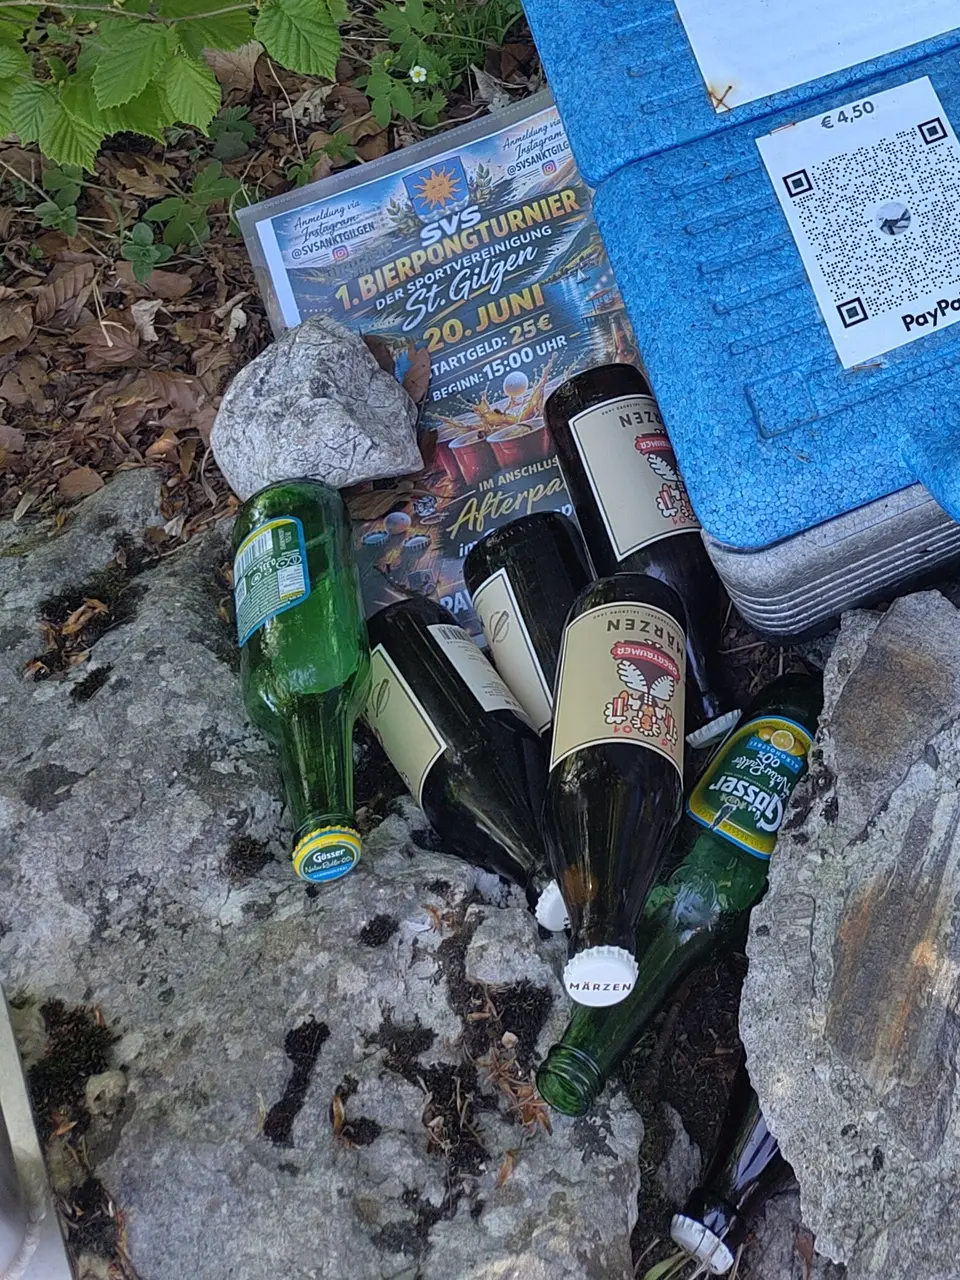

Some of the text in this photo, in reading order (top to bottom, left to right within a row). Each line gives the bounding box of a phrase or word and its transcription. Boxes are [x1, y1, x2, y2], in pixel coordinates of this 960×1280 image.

[820, 99, 876, 130] € 4,50
[503, 123, 548, 151] Anmeldung
[507, 140, 569, 176] @SVSANKTGILG
[293, 204, 346, 231] Anmeldung
[419, 203, 482, 247] SVS
[335, 189, 581, 311] 1. BIERPONGTURNIER
[375, 224, 552, 311] DER SPORTVEREINIGUNG
[402, 245, 539, 332] St. Gilgen
[423, 283, 546, 353] 20. JUNI
[429, 313, 553, 380] TARTGELD: 25€
[432, 333, 568, 402] BEGINN: 15:00 UHR
[618, 410, 664, 428] RZEN
[478, 456, 558, 493] IM ANSCHLUS
[446, 476, 566, 540] Afterpa
[606, 618, 684, 661] MÄRZEN
[616, 646, 678, 676] OBERTRUMER
[708, 775, 784, 832] Gösser
[312, 848, 346, 863] Gösser
[568, 981, 632, 991] MÄRZEN
